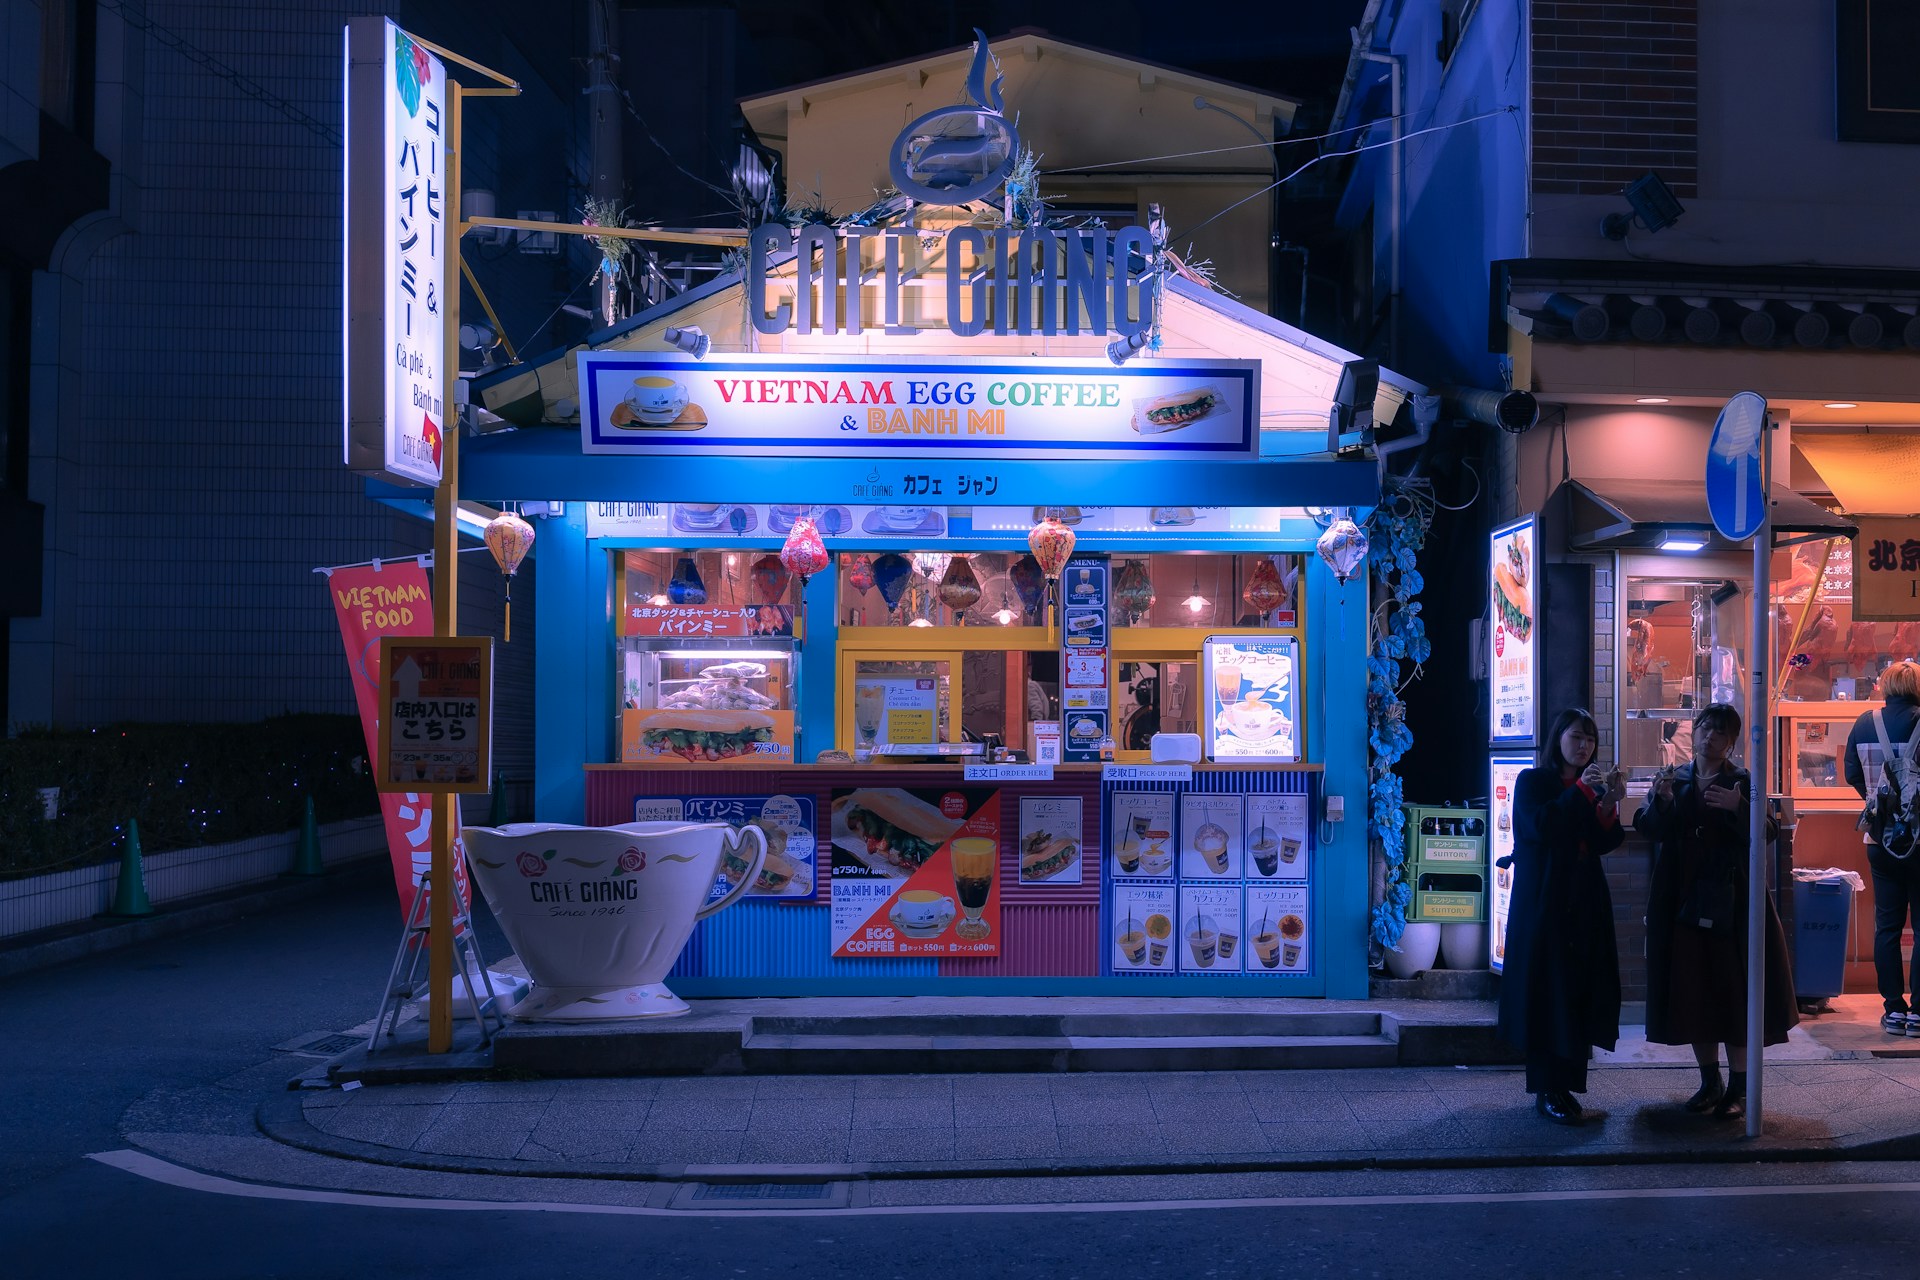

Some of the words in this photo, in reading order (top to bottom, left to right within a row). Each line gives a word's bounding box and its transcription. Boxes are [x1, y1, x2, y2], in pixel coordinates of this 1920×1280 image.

[426, 98, 440, 259] コーヒー
[400, 137, 420, 338] バインミー
[427, 281, 438, 317] &
[409, 351, 424, 376] phê
[714, 379, 897, 405] VIETNAM
[906, 381, 977, 406] EGG
[986, 381, 1121, 408] COFFEE
[840, 414, 859, 431] &
[867, 408, 959, 435] BANH
[967, 408, 1006, 435] MI
[903, 474, 942, 496] カフェ
[958, 474, 998, 496] ジャン
[338, 584, 427, 610] VIETNAM
[361, 607, 414, 631] FOOD
[658, 619, 727, 634] バインミー
[1218, 654, 1286, 665] エッグコーヒー
[395, 701, 476, 719] 店内入口は
[402, 719, 466, 741] こちら
[968, 768, 998, 778] 注文口
[1107, 768, 1137, 778] 受取口
[686, 800, 760, 817] バインミー
[530, 878, 576, 902] CAFÉ
[833, 885, 872, 896] BANH
[874, 886, 891, 896] MI
[548, 905, 586, 917] Since
[591, 904, 626, 917] 1946
[865, 928, 895, 940] EGG
[846, 940, 895, 952] COFFEE
